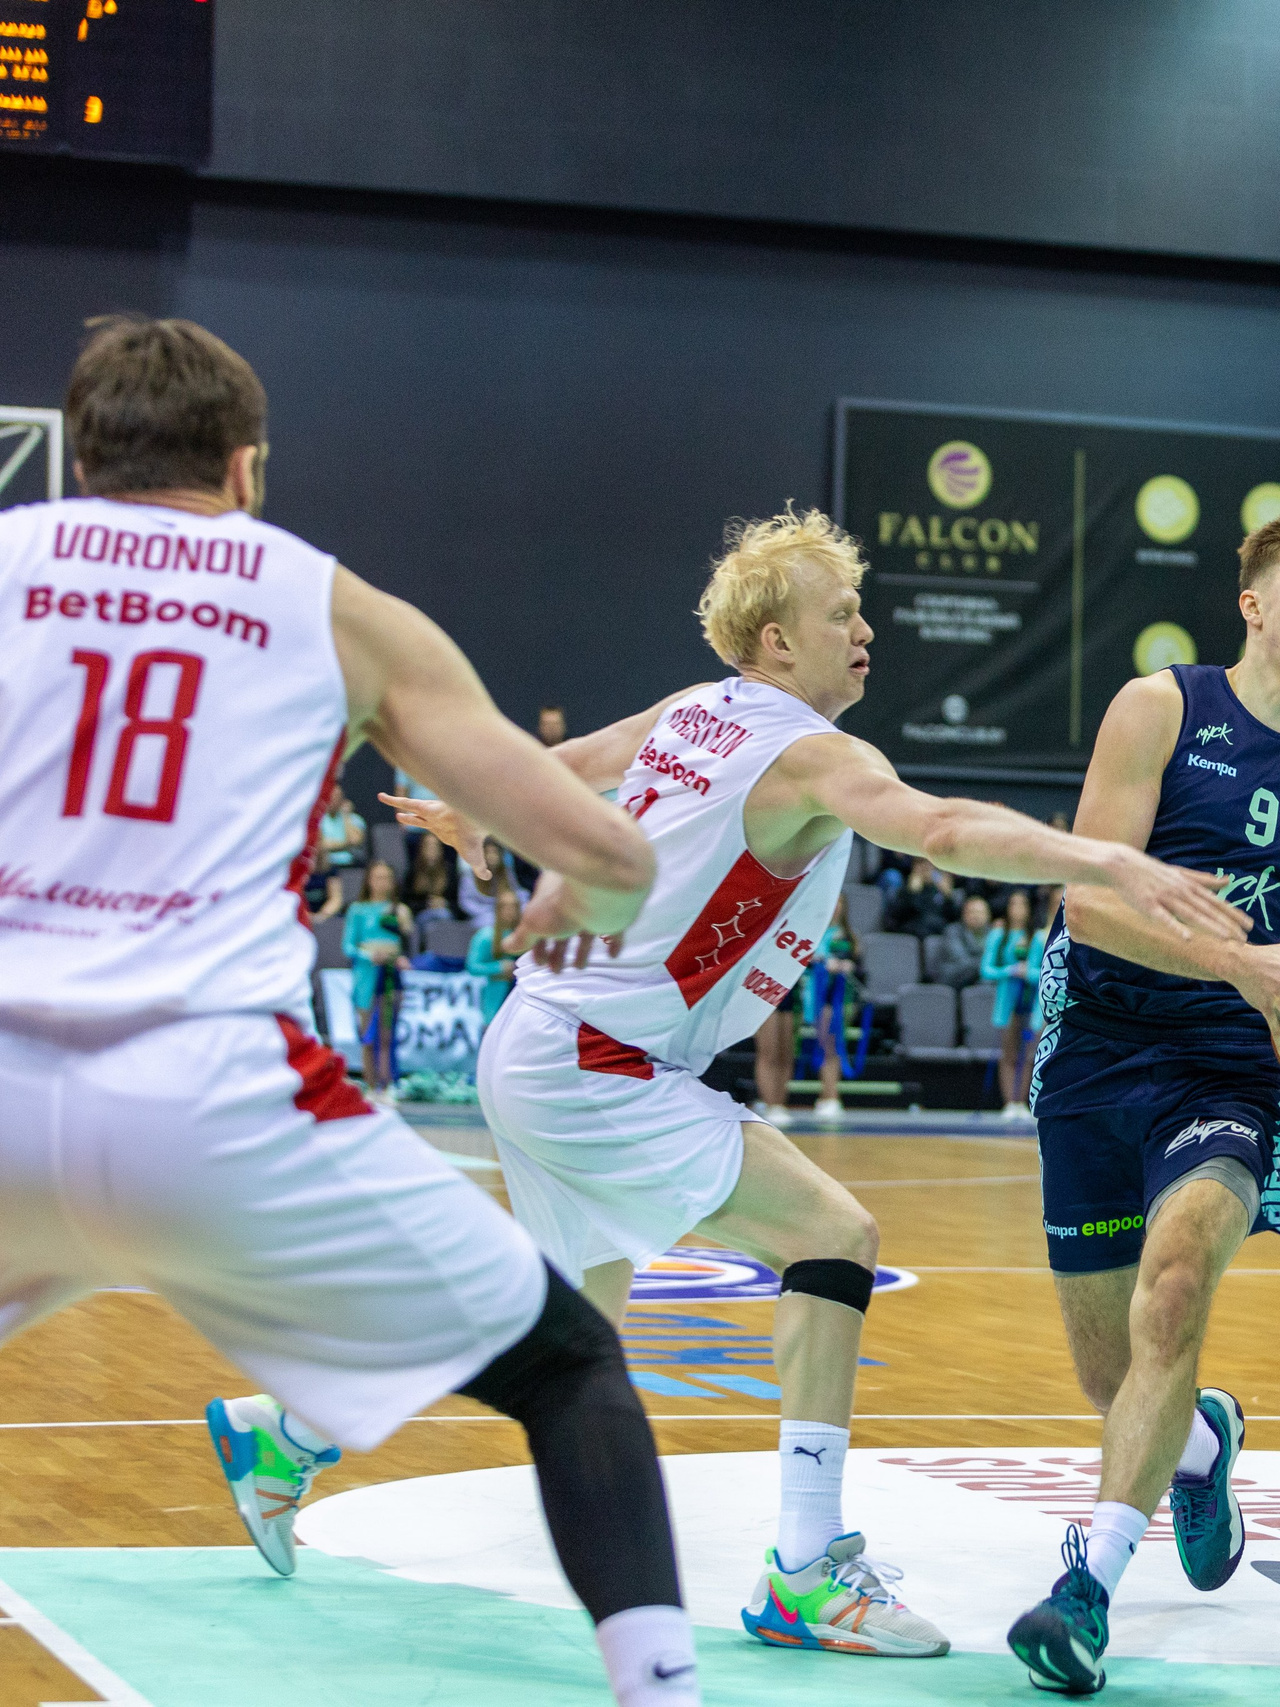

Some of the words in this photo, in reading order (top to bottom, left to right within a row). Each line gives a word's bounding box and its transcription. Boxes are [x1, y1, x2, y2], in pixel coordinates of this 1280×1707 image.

[53, 521, 266, 582] VORONOV
[878, 511, 1040, 555] FALCON
[25, 584, 270, 649] BetBoom
[62, 646, 206, 824] 18
[1187, 752, 1238, 778] Kempa
[1245, 787, 1280, 848] 9
